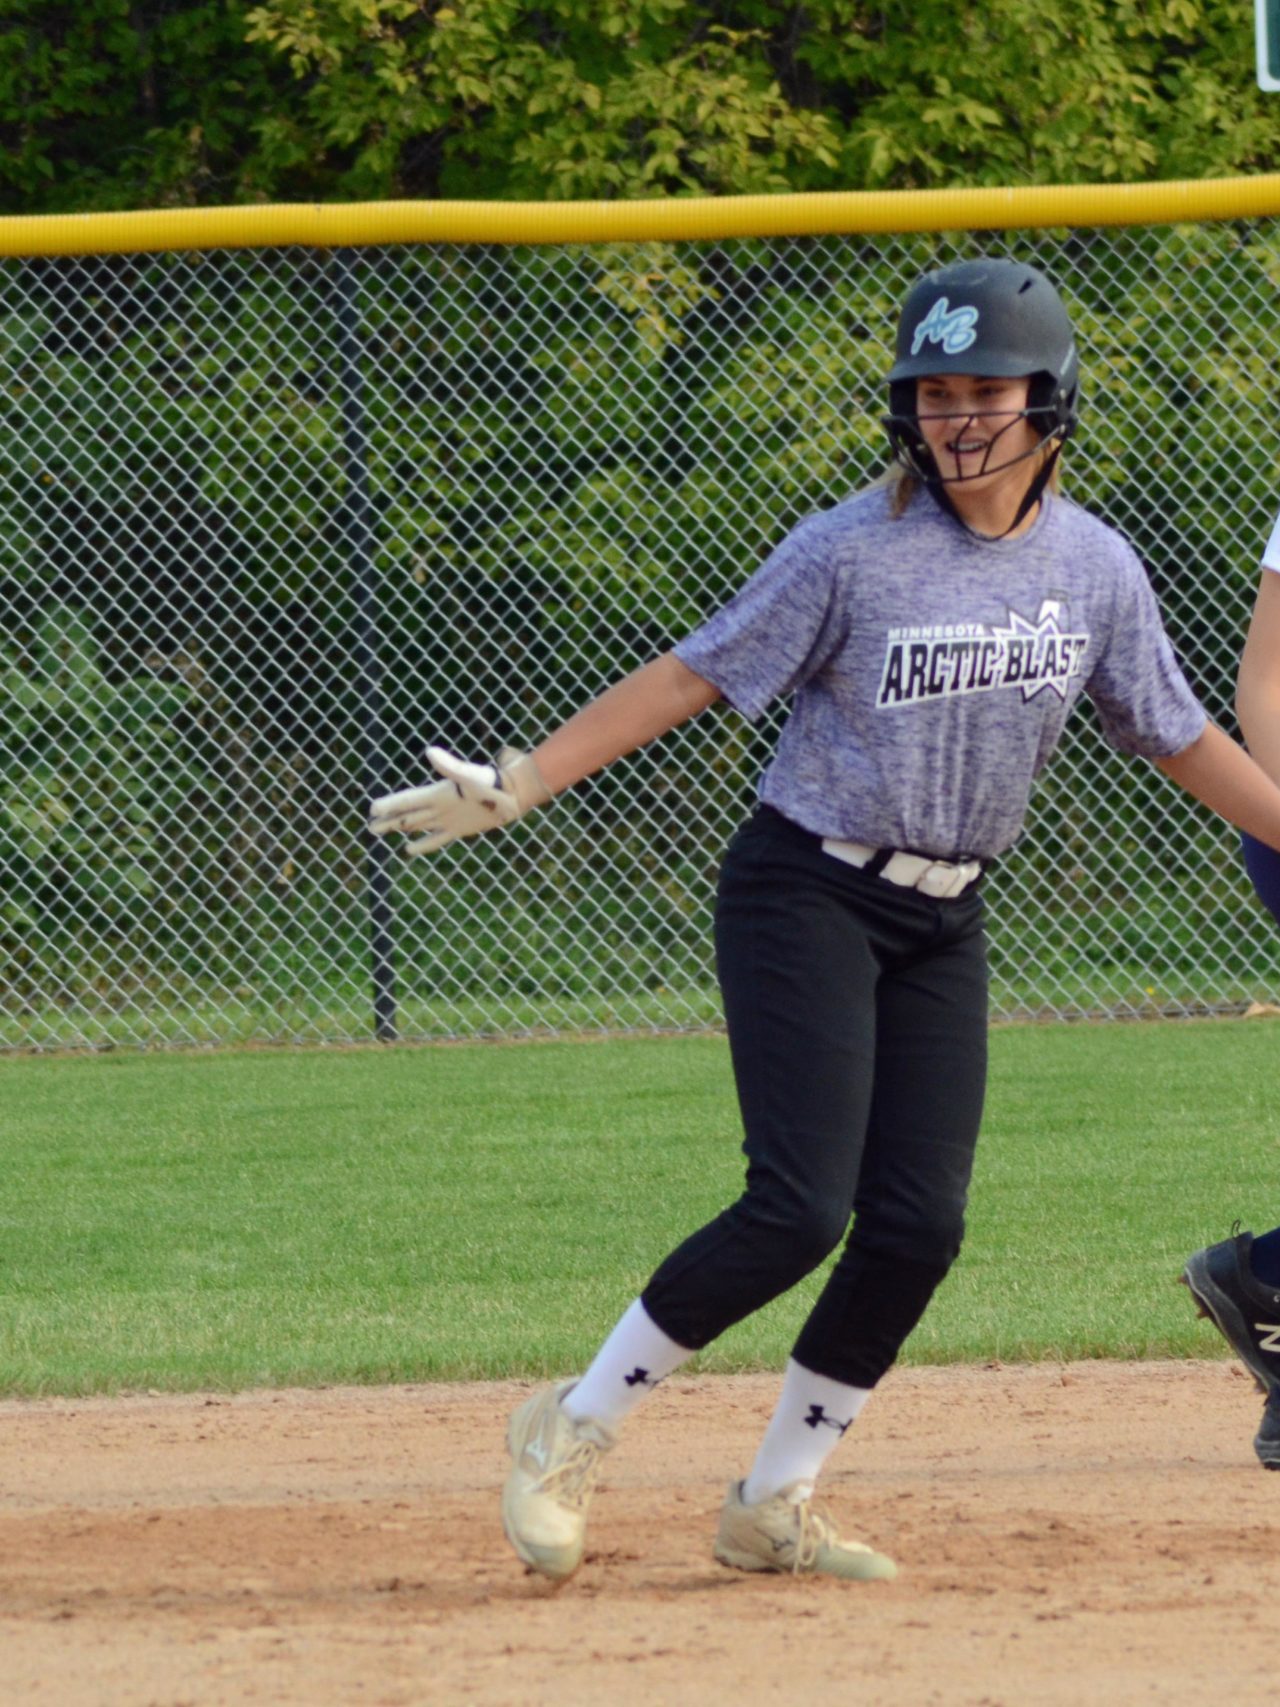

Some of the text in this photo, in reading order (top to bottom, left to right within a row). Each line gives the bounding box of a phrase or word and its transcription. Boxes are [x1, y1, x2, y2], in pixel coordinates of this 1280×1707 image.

[887, 623, 985, 641] MINNESOTA
[878, 635, 1089, 706] ARCTIC BLAST
